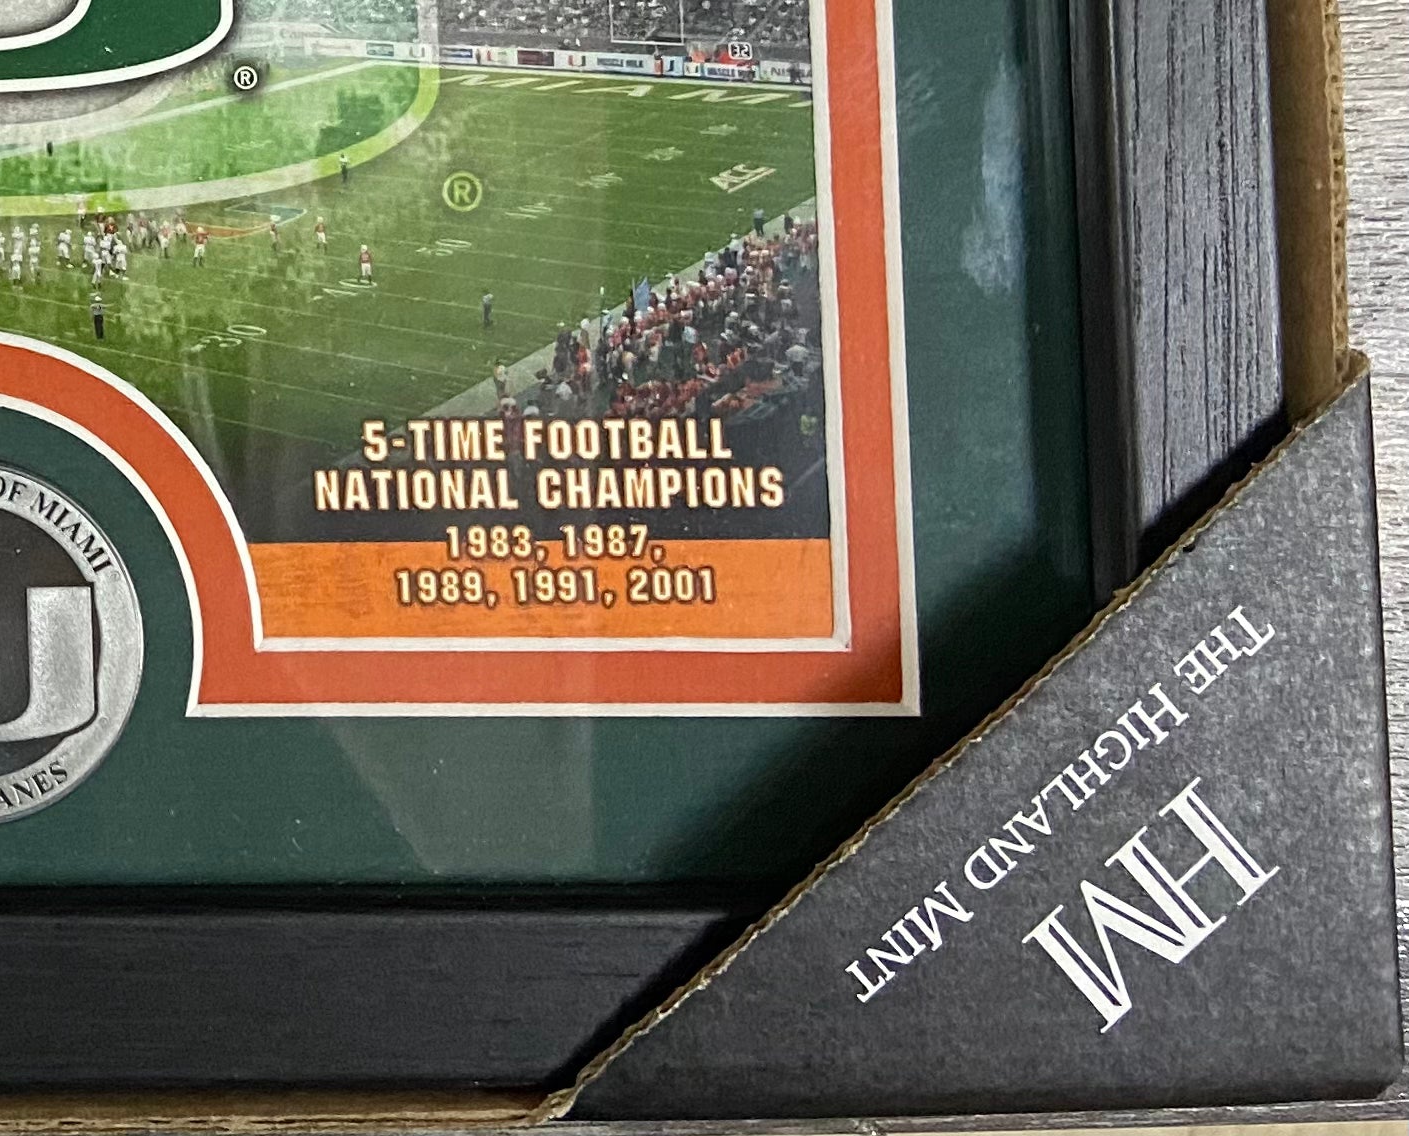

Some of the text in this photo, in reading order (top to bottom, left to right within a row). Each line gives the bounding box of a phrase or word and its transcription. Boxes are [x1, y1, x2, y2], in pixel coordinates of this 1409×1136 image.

[361, 417, 733, 462] 5-TIME FOOTBALL
[313, 466, 785, 511] NATIONAL CHAMPIONS
[29, 489, 113, 574] MIAMI
[446, 523, 666, 563] 1983, 1987,
[395, 567, 718, 608] 1989, 1991, 2001
[1021, 776, 1281, 1034] HM
